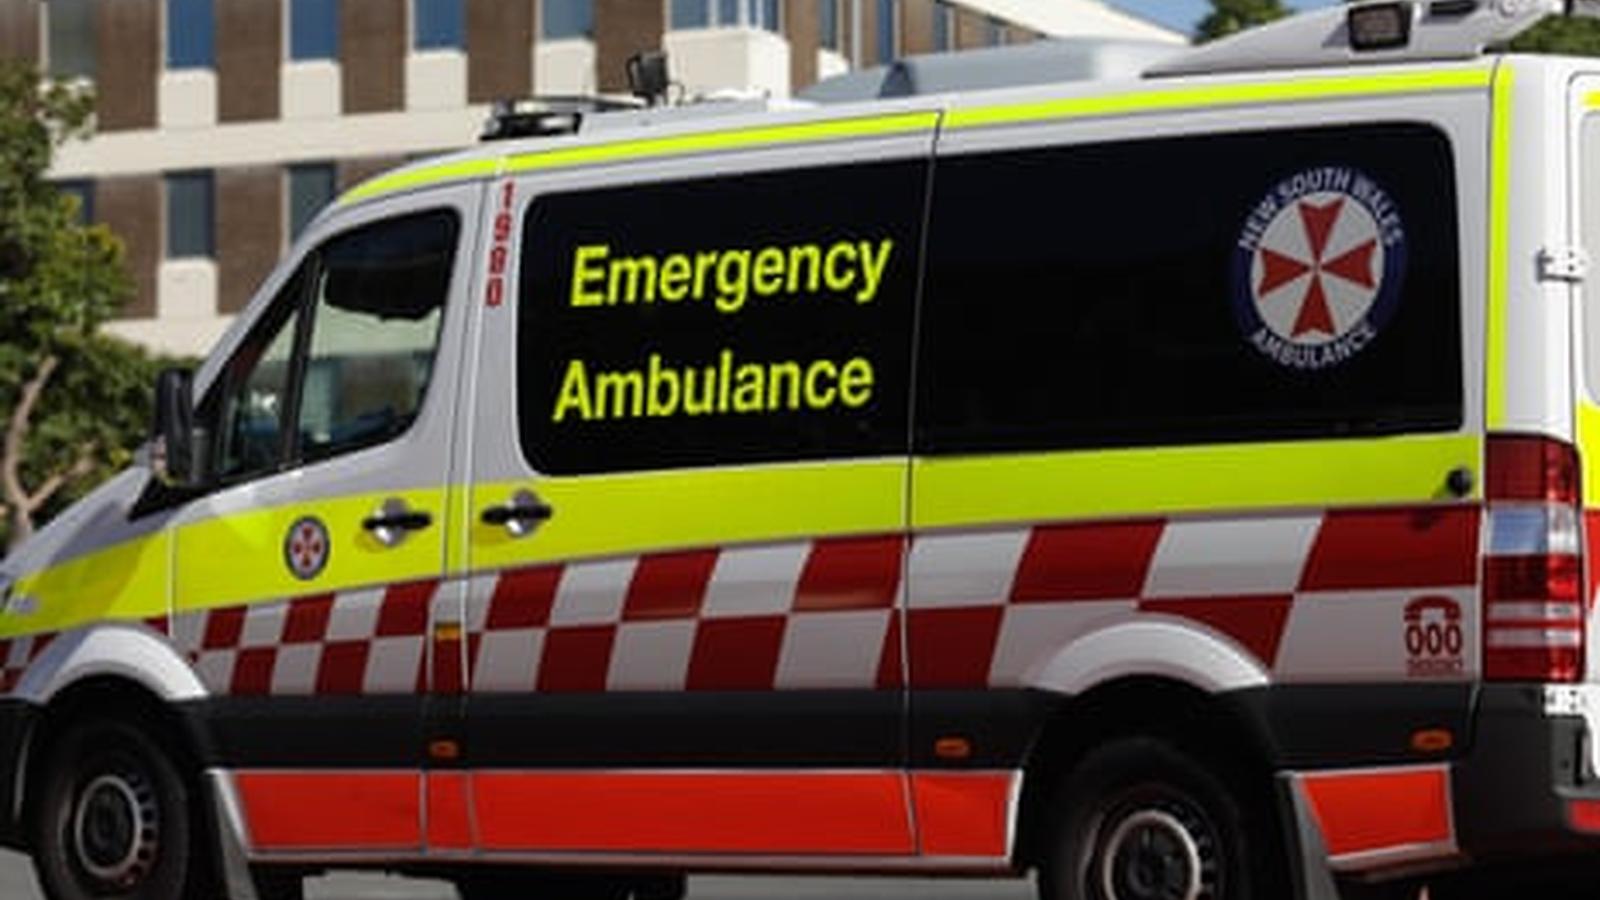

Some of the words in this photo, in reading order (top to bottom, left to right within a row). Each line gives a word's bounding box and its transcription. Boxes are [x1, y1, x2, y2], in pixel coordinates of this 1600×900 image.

[1237, 194, 1278, 251] NEW
[1277, 168, 1351, 199] SOUTH
[1352, 175, 1404, 247] WALES
[570, 239, 893, 312] Emergency
[1252, 320, 1377, 369] AMBULANCE
[552, 349, 874, 422] Ambulance
[1405, 623, 1463, 656] 000
